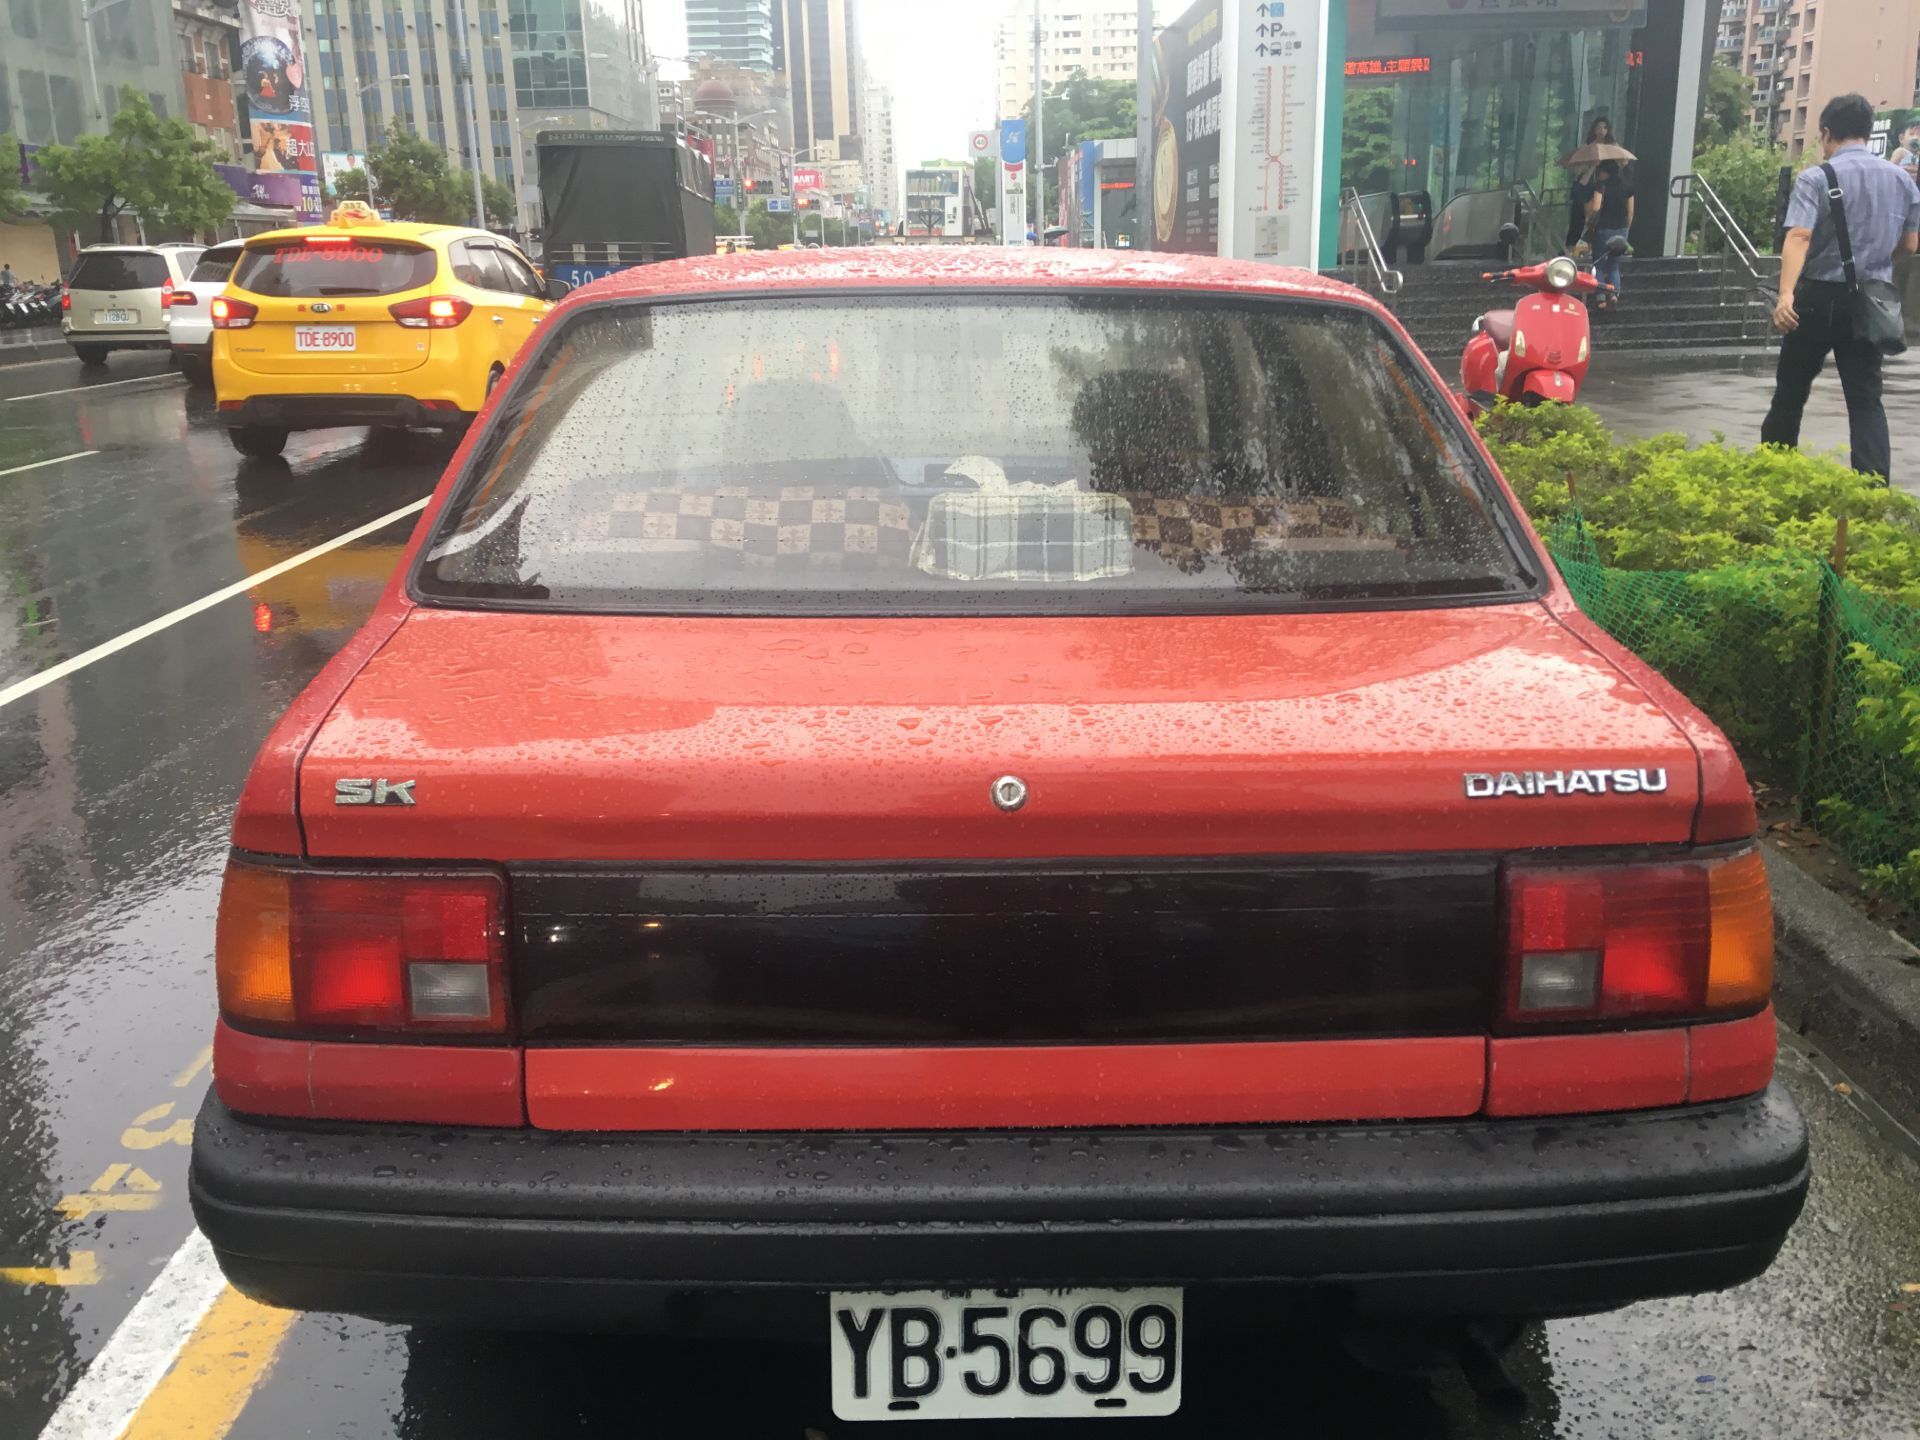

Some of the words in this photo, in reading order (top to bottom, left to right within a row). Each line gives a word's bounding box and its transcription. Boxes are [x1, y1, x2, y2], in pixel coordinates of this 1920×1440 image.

[274, 246, 383, 264] TDE-8900
[312, 303, 329, 312] KIA
[297, 331, 355, 347] TDE-8900
[335, 777, 417, 806] SK
[1464, 768, 1668, 798] DAIHATSU
